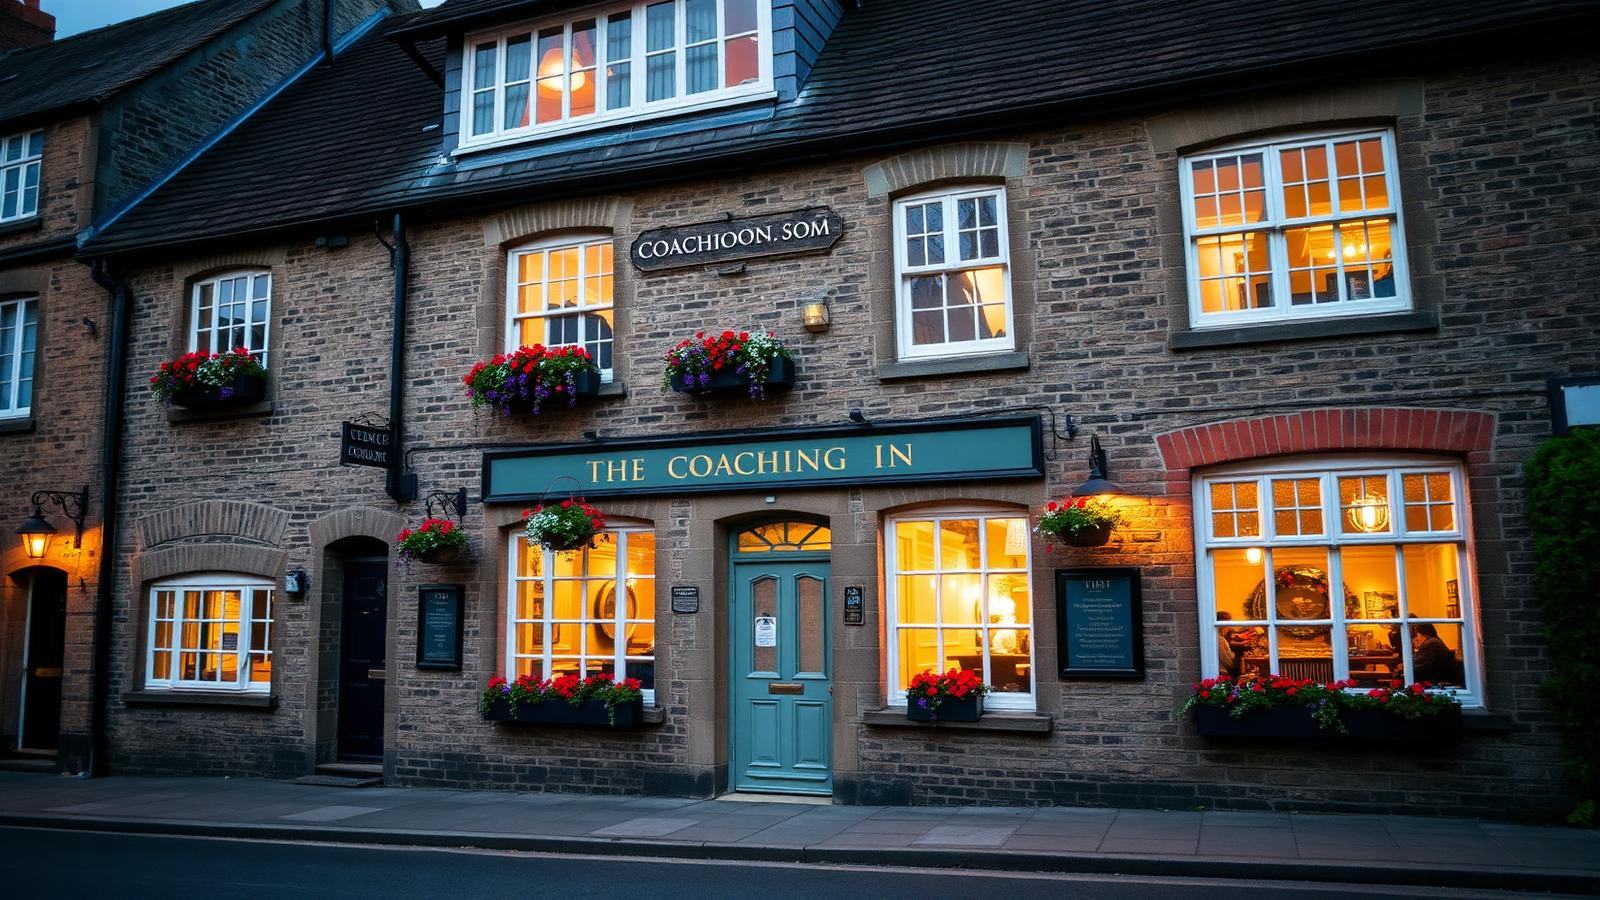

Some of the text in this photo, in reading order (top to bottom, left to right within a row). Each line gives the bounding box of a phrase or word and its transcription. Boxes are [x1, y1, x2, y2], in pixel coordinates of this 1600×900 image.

[586, 443, 913, 483] THE COACHING IN
